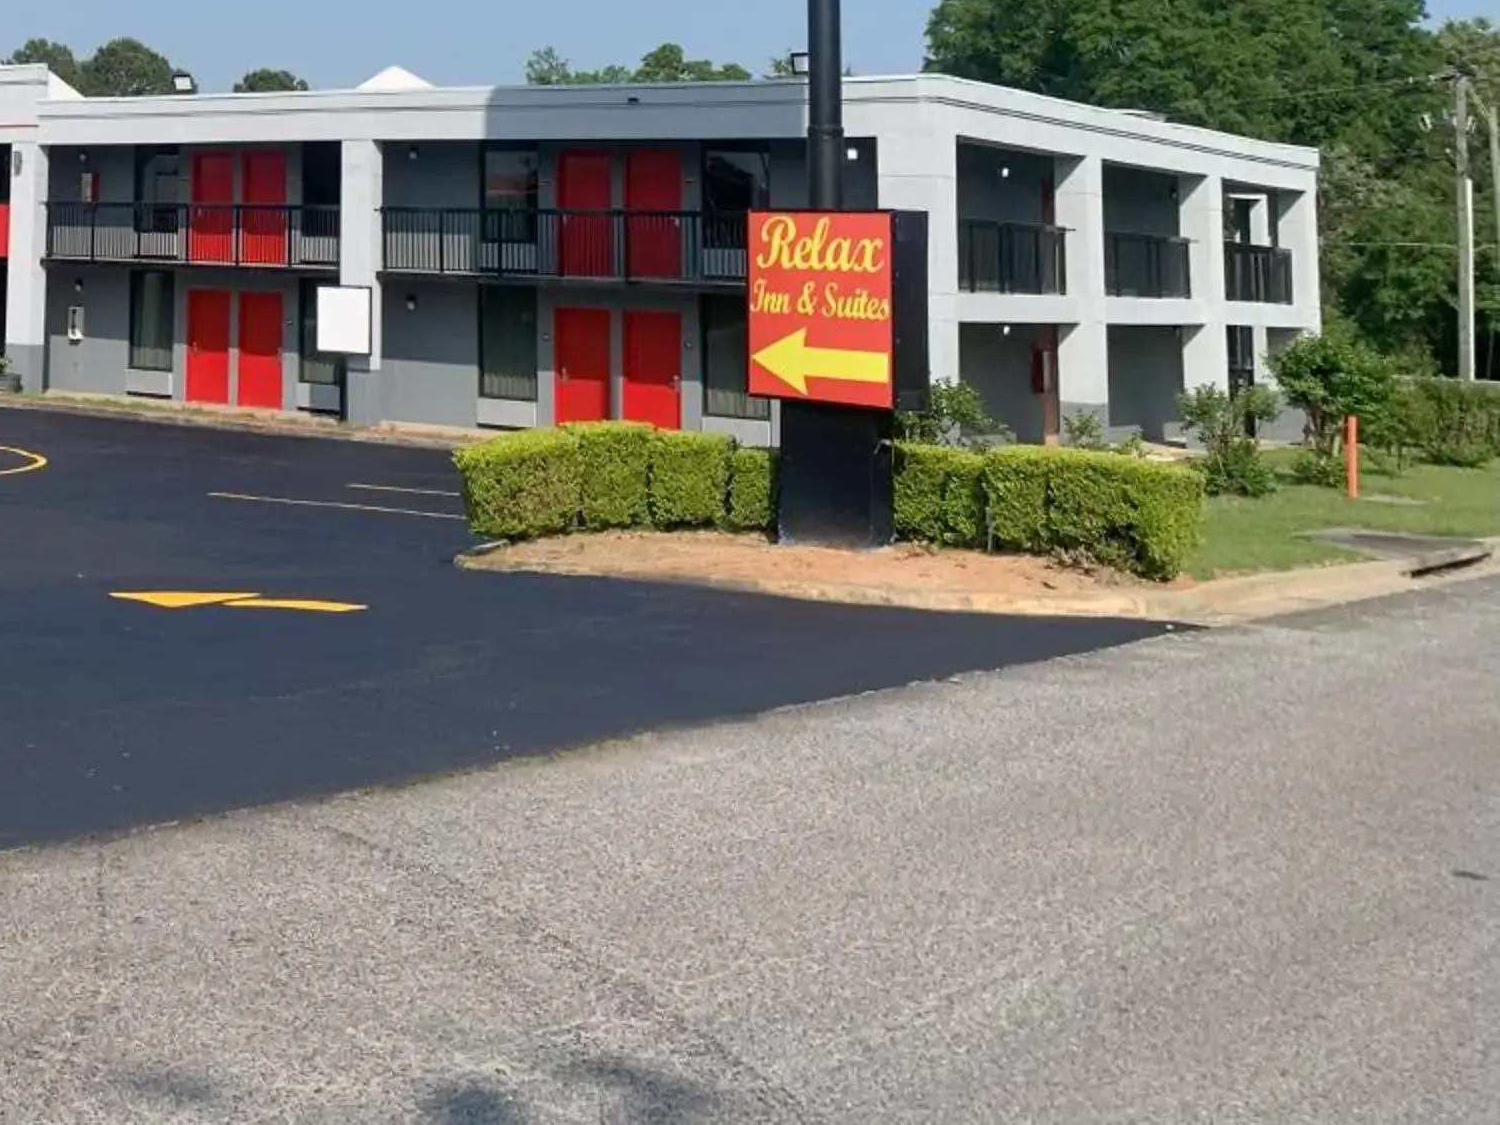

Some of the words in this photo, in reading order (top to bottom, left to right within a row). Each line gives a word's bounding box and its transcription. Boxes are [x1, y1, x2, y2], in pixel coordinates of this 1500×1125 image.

[756, 215, 885, 273] Relax
[750, 278, 789, 314] Inn
[797, 280, 818, 316] &
[822, 282, 890, 321] Suites
